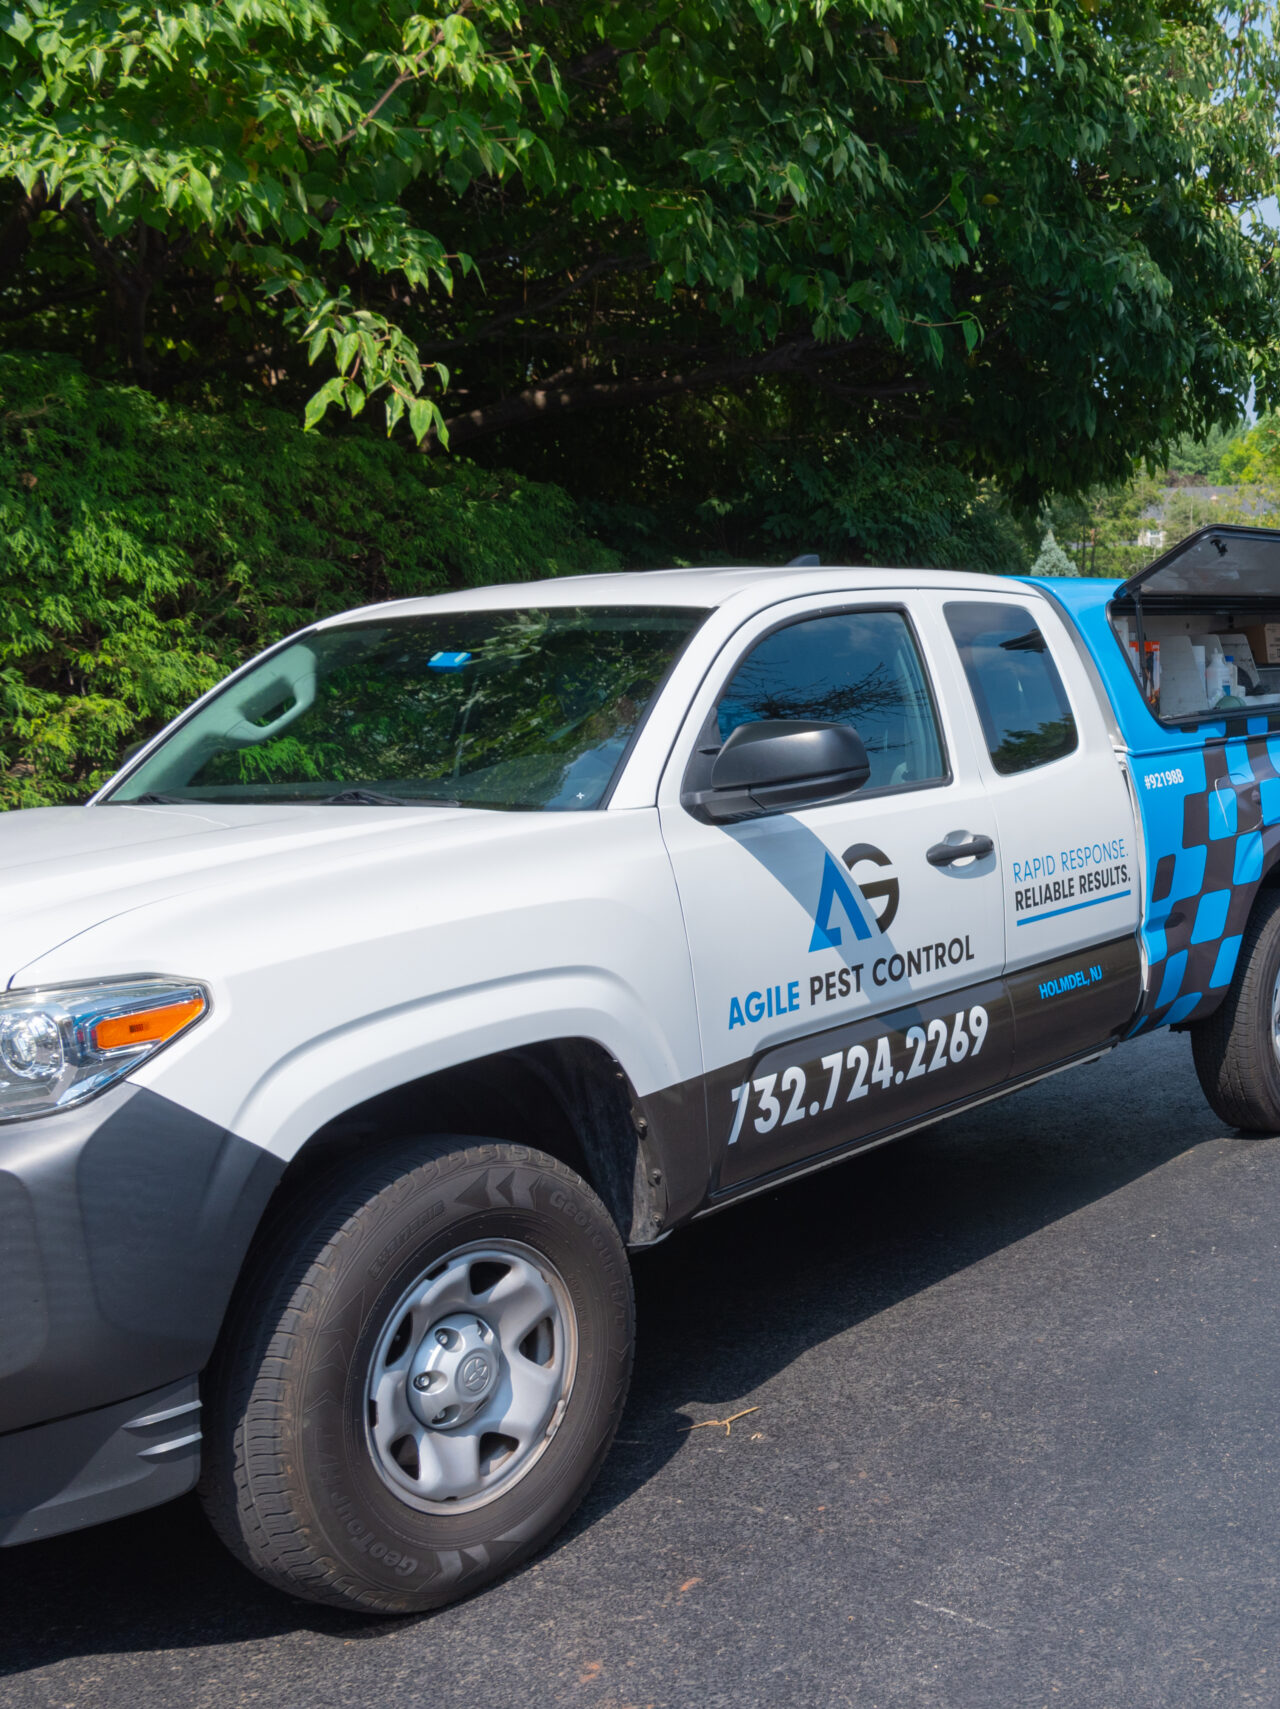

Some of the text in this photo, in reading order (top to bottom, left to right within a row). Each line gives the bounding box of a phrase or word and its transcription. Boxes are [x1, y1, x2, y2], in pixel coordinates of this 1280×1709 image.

[1144, 768, 1184, 789] #92198B
[1013, 838, 1129, 883] RAPID RESPONSE.
[1015, 865, 1132, 912] RELIABLE RESULTS.
[728, 934, 975, 1030] AGILE PEST CONTROL
[1038, 964, 1103, 1000] HOLMDEL, NJ
[727, 1005, 989, 1146] 732.724.2269
